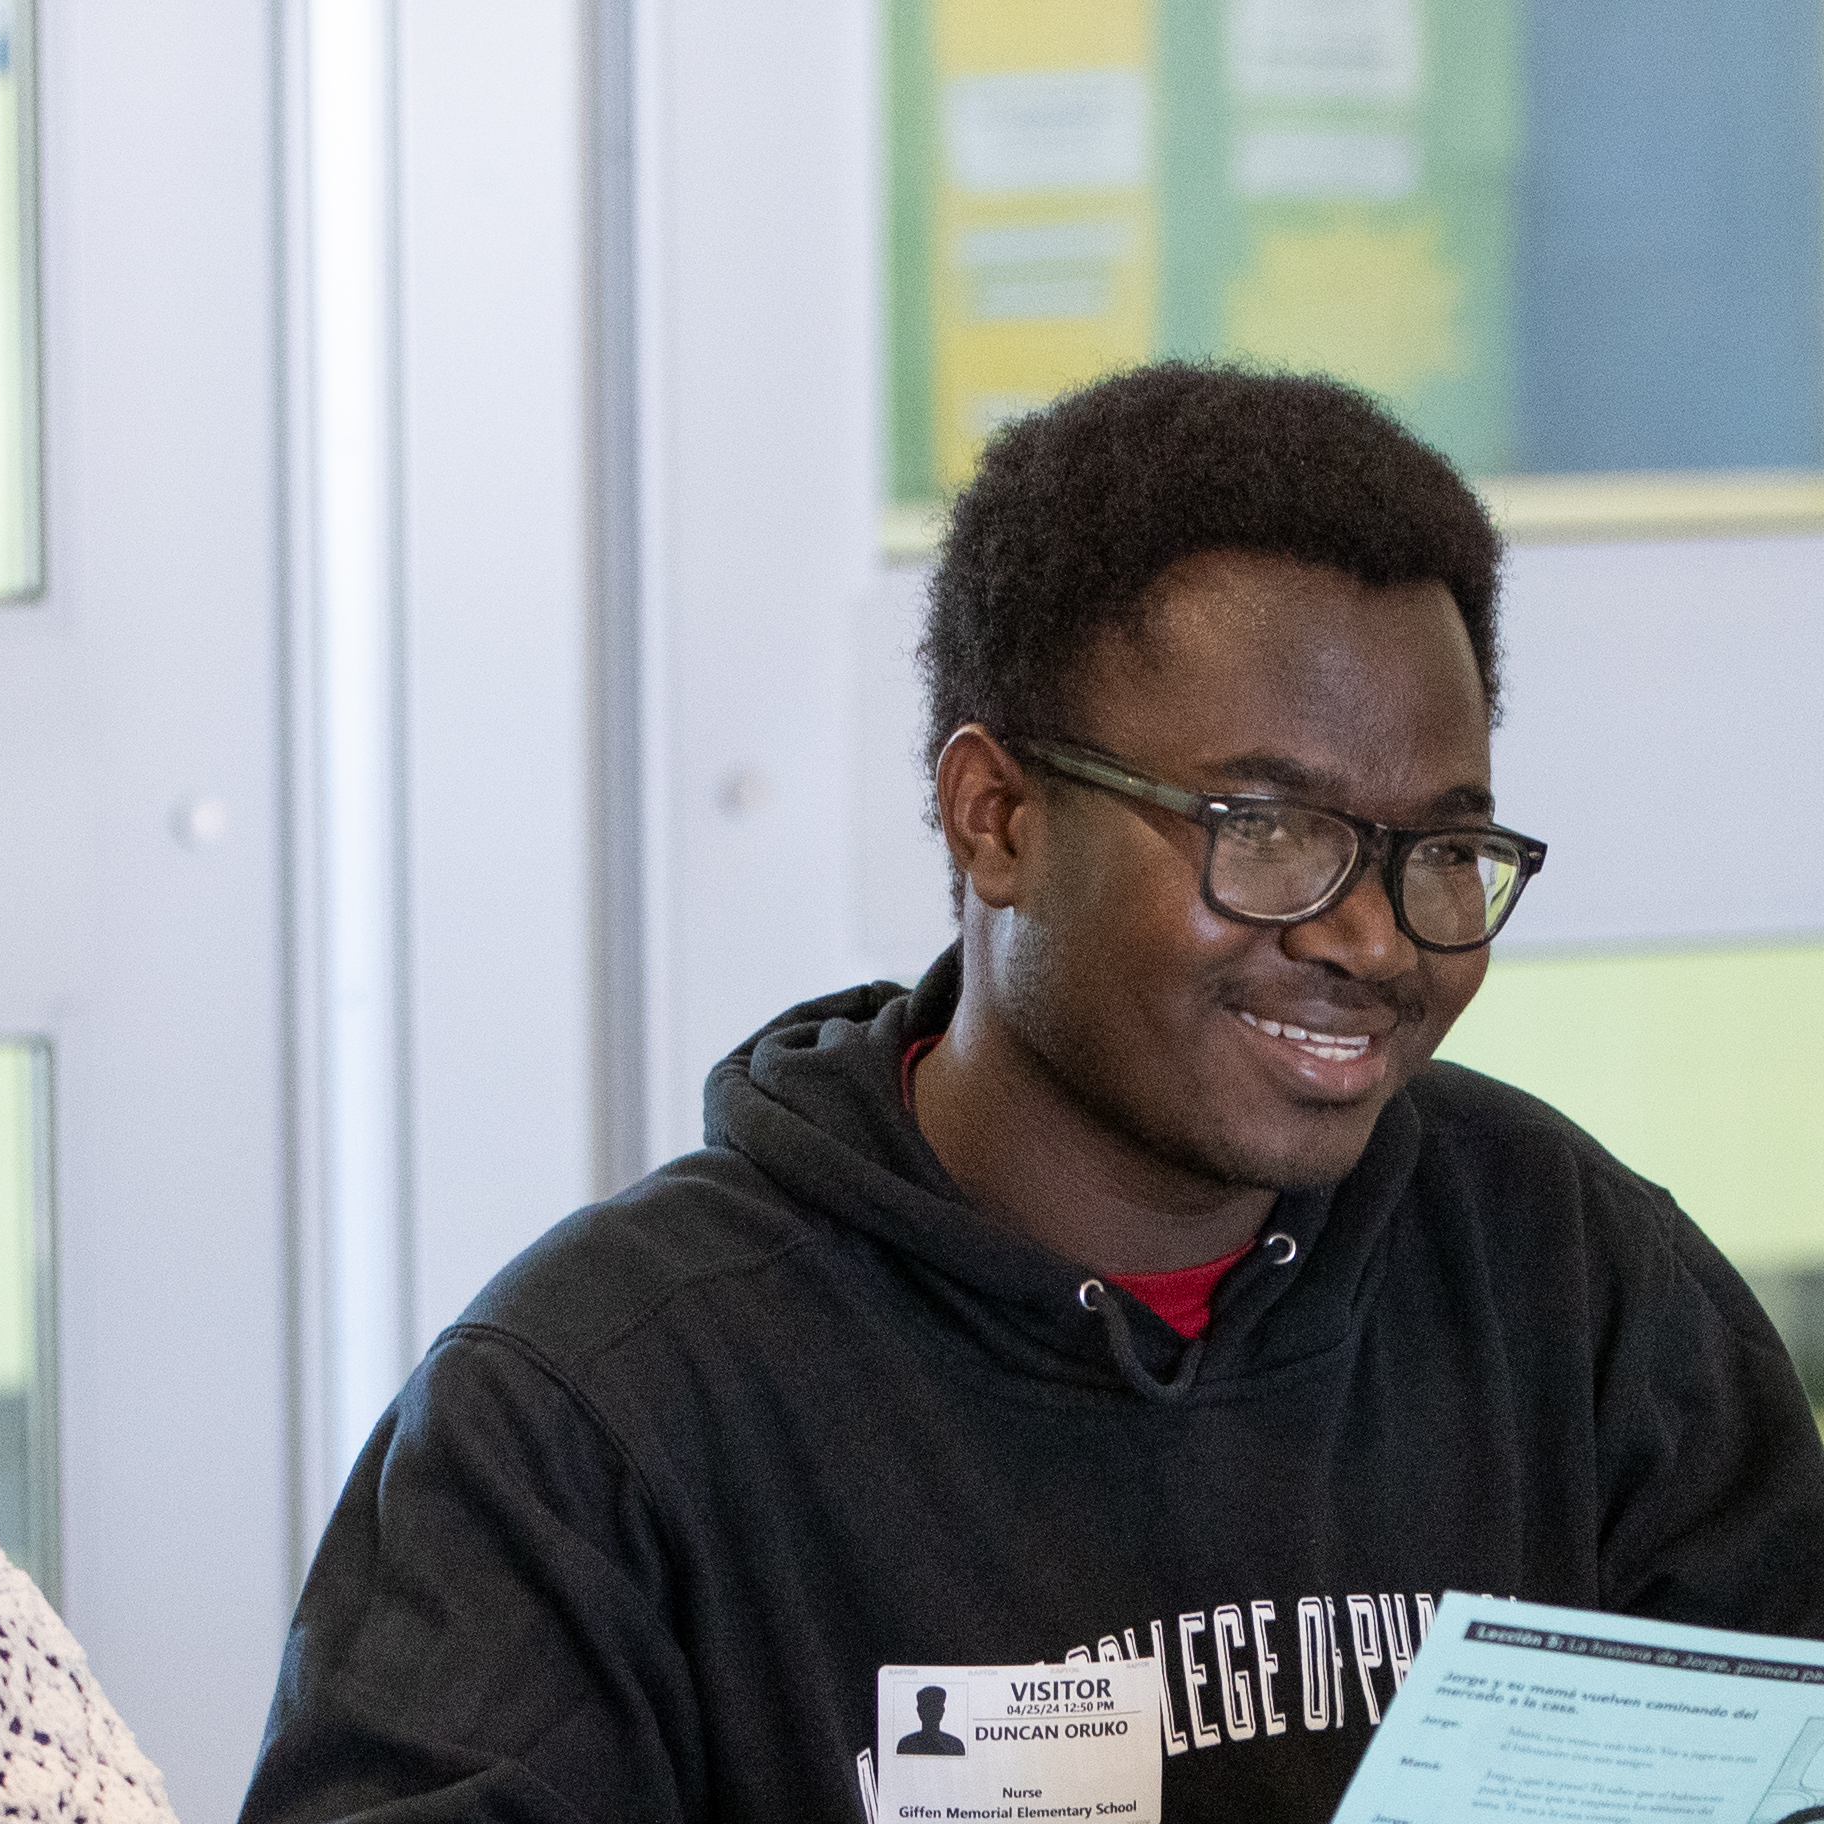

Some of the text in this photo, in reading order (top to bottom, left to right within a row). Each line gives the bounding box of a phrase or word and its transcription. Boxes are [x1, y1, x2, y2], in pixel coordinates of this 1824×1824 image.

[1590, 1640, 1652, 1662] historia
[1655, 1650, 1678, 1664] de
[1735, 1662, 1800, 1680] primera
[1010, 1678, 1112, 1702] VISITOR
[1435, 1686, 1505, 1703] mercado
[1523, 1695, 1537, 1708] la
[1443, 1671, 1488, 1687] Jorge
[1582, 1692, 1641, 1708] vuelven
[1645, 1701, 1729, 1718] caminando
[1732, 1708, 1759, 1721] del
[1007, 1700, 1115, 1716] 04/25/24 12:50 PM
[975, 1721, 1128, 1741] DUNCAN ORUKO
[1002, 1787, 1043, 1799] Nurse
[898, 1800, 1137, 1820] Giffen Memorial Elementary School
